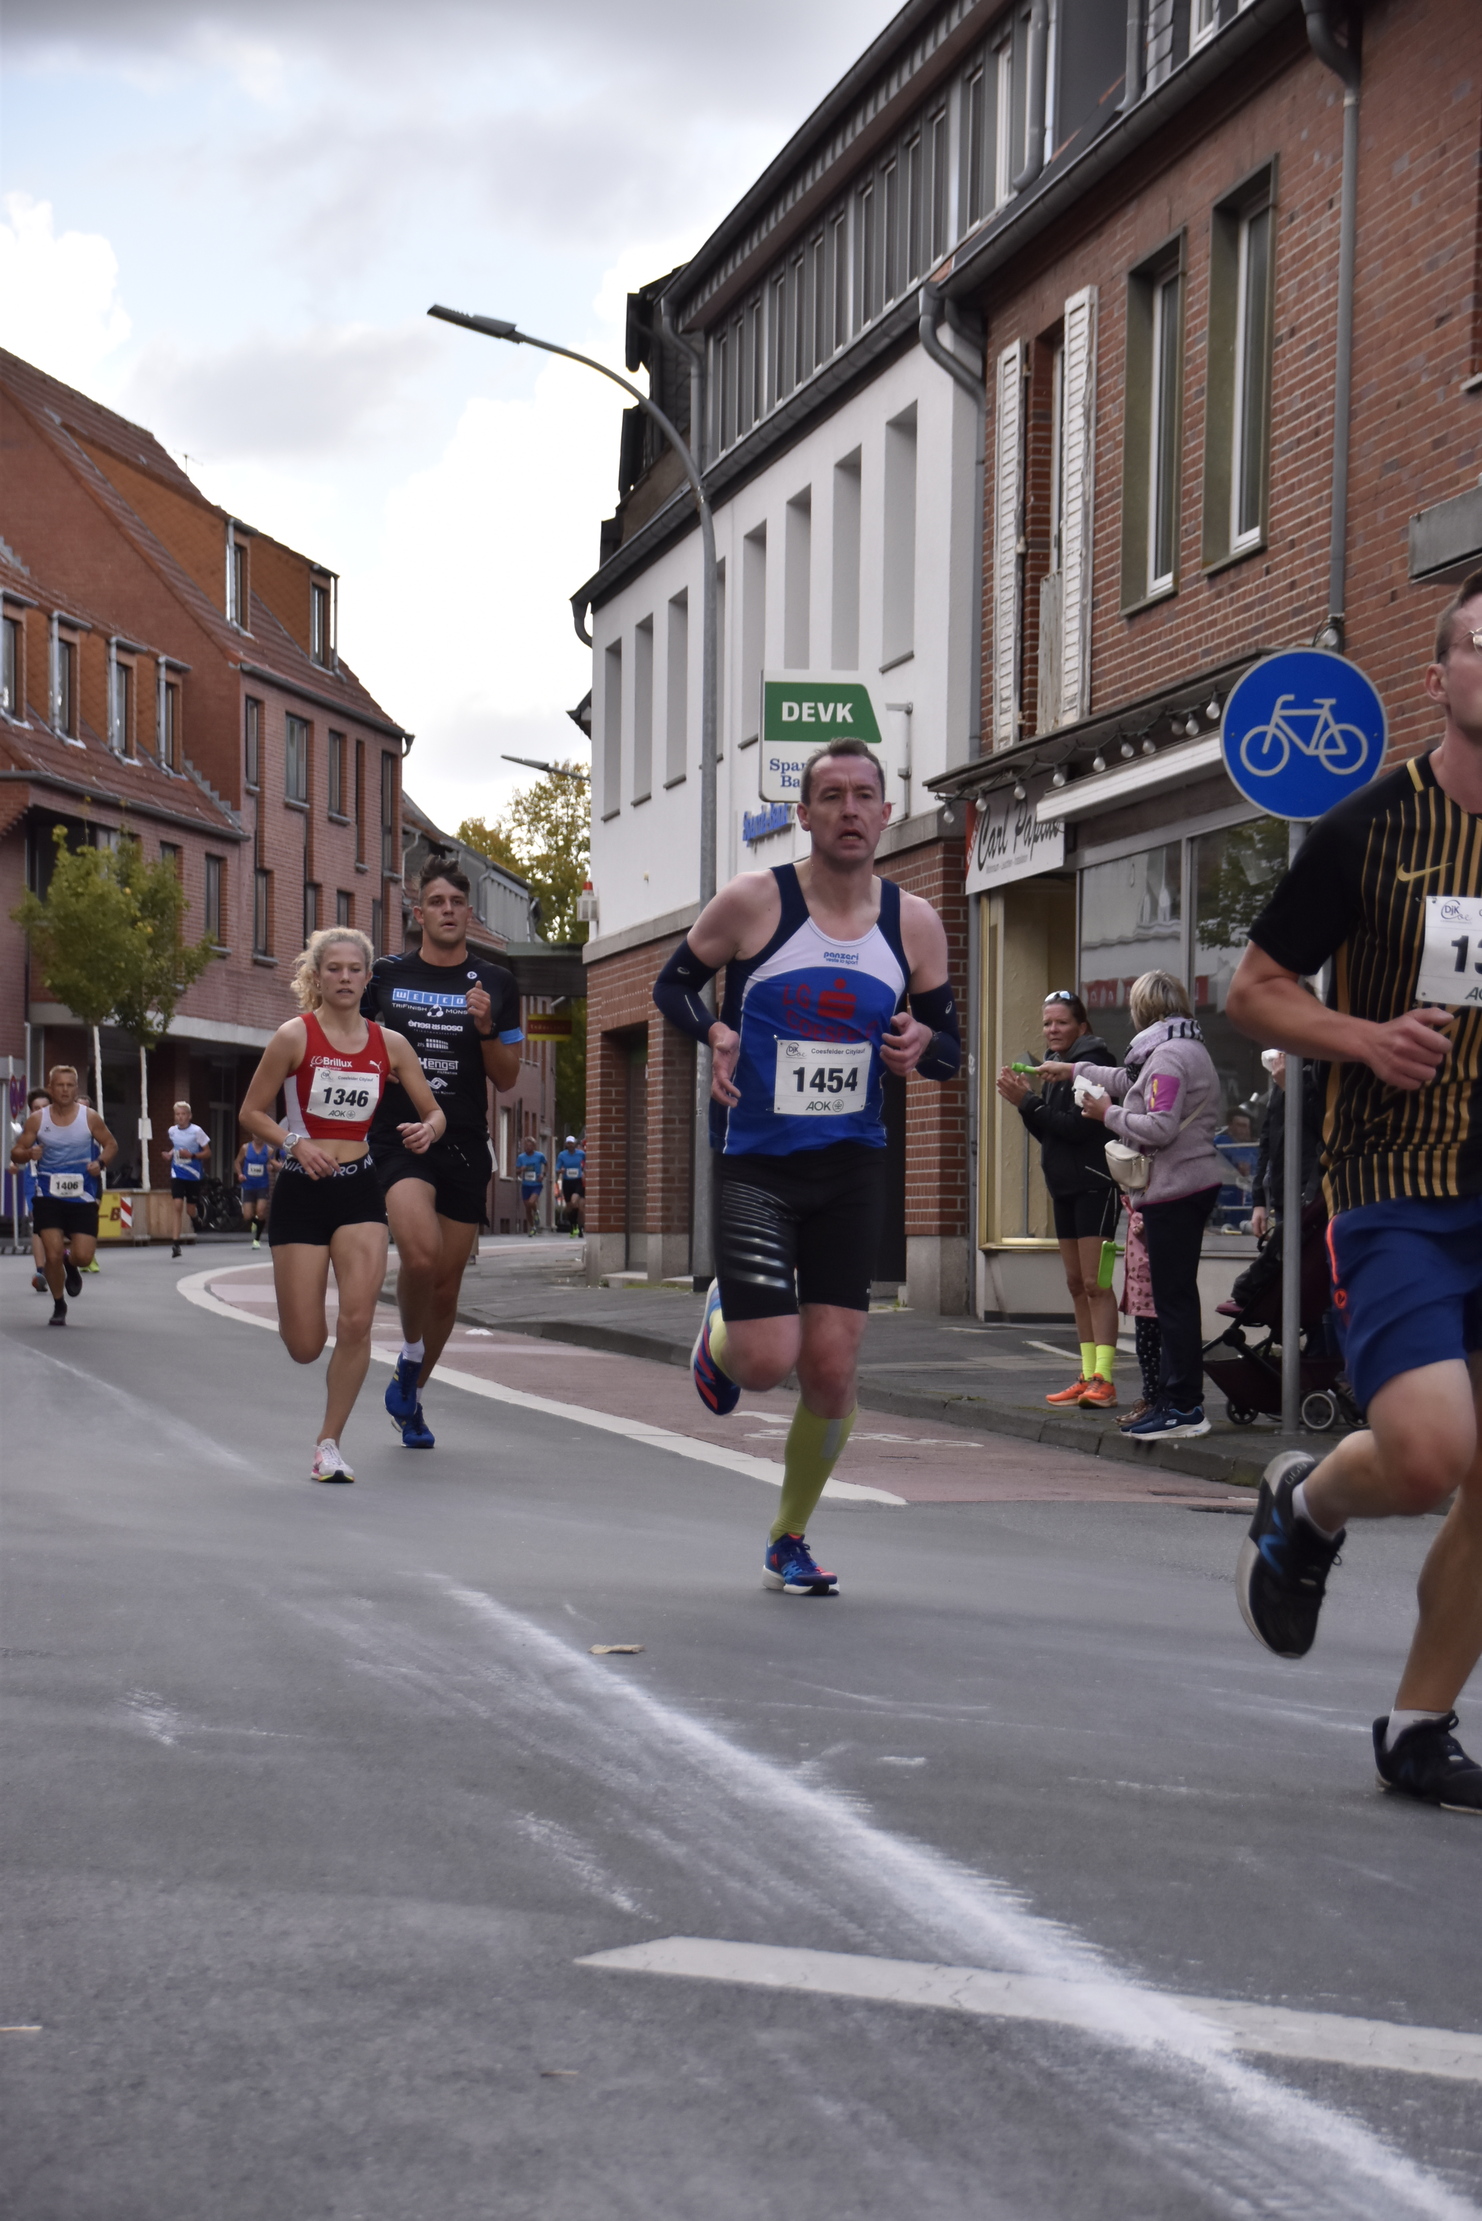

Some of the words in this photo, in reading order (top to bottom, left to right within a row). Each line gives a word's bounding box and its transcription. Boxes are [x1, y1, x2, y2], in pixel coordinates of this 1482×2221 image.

[782, 701, 853, 723] DEVK
[769, 758, 806, 774] Spar
[780, 775, 801, 788] Ba
[978, 803, 1009, 871] Carl
[823, 952, 859, 960] panzeri
[396, 991, 464, 1005] WEICO
[783, 983, 811, 1010] LG
[1465, 987, 1482, 1001] A
[786, 1009, 879, 1044] COESFE
[845, 1048, 866, 1056] Citylauf
[323, 1056, 353, 1067] Brillux
[418, 1057, 459, 1071] Hengst
[793, 1067, 859, 1093] 1454
[323, 1087, 369, 1107] 1346
[806, 1101, 831, 1111] AOK
[328, 1109, 346, 1118] AOK
[363, 1154, 373, 1169] NI
[56, 1181, 79, 1190] 1406
